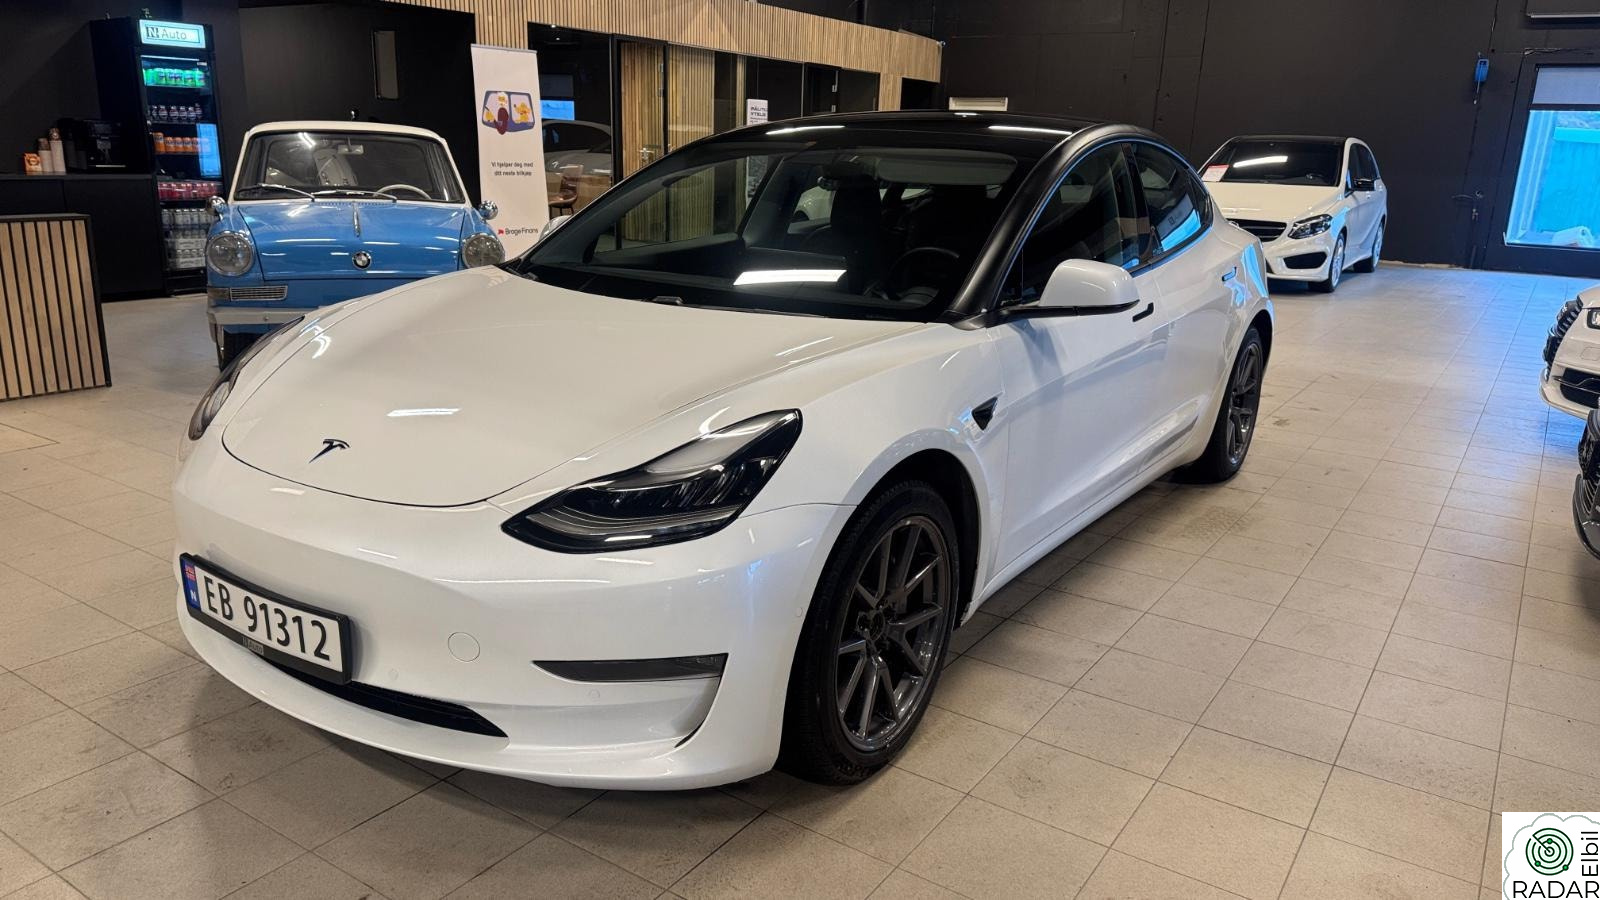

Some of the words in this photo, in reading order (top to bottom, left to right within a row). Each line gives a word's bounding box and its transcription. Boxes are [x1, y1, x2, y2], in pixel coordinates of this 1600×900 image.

[161, 28, 187, 40] Auto
[204, 575, 234, 621] EB
[243, 595, 330, 661] 91312
